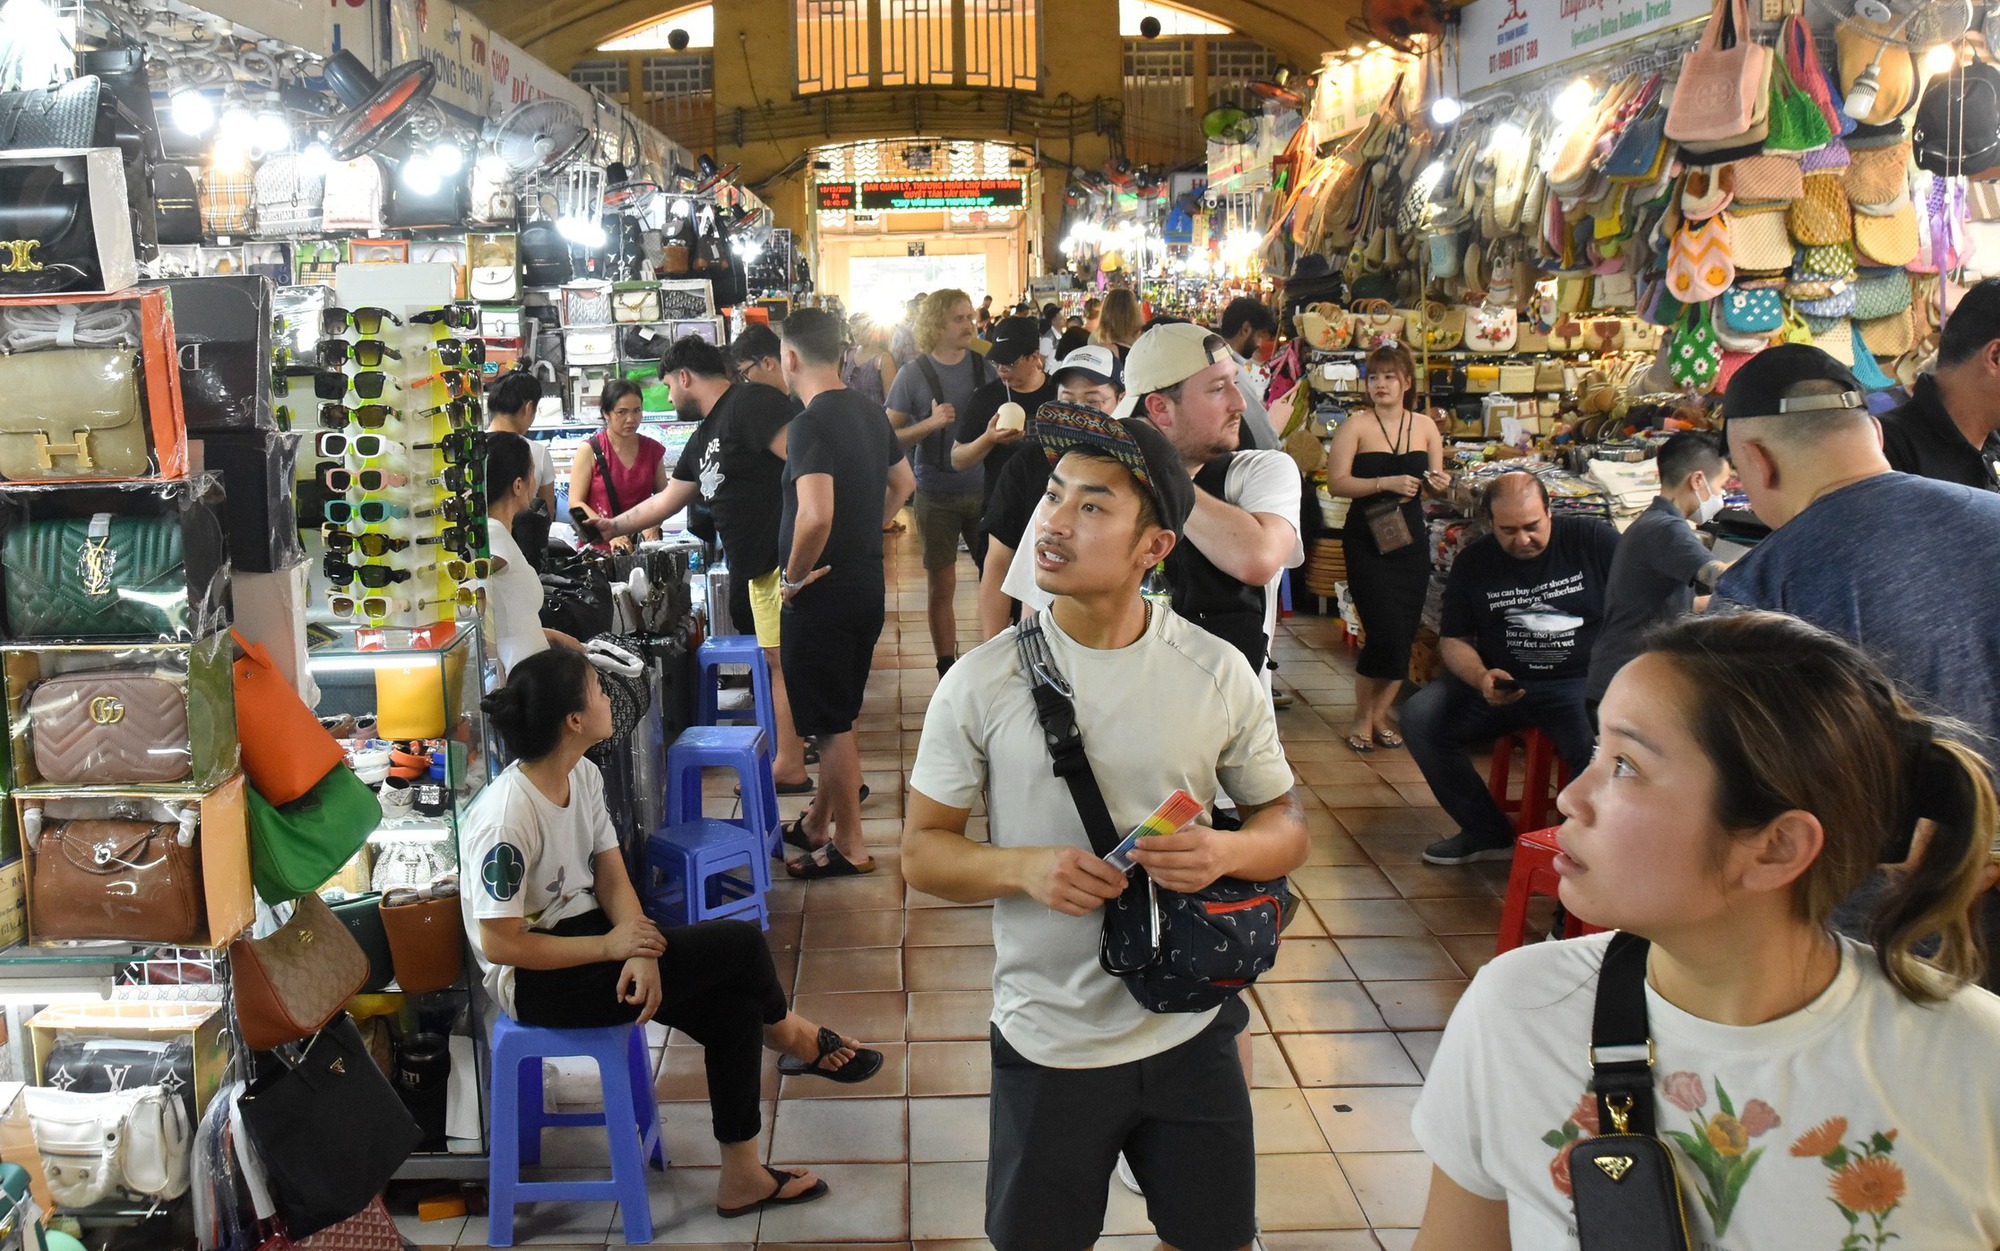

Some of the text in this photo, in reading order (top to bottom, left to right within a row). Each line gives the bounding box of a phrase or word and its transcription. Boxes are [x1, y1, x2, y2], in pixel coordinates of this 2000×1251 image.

[1486, 570, 1584, 599] You can buy other shoes and
[1489, 582, 1585, 612] pretend they're Timberland.
[1505, 629, 1517, 638] You
[1532, 631, 1548, 639] also
[1506, 640, 1523, 648] your
[1524, 639, 1537, 648] feet
[1561, 639, 1575, 648] wet
